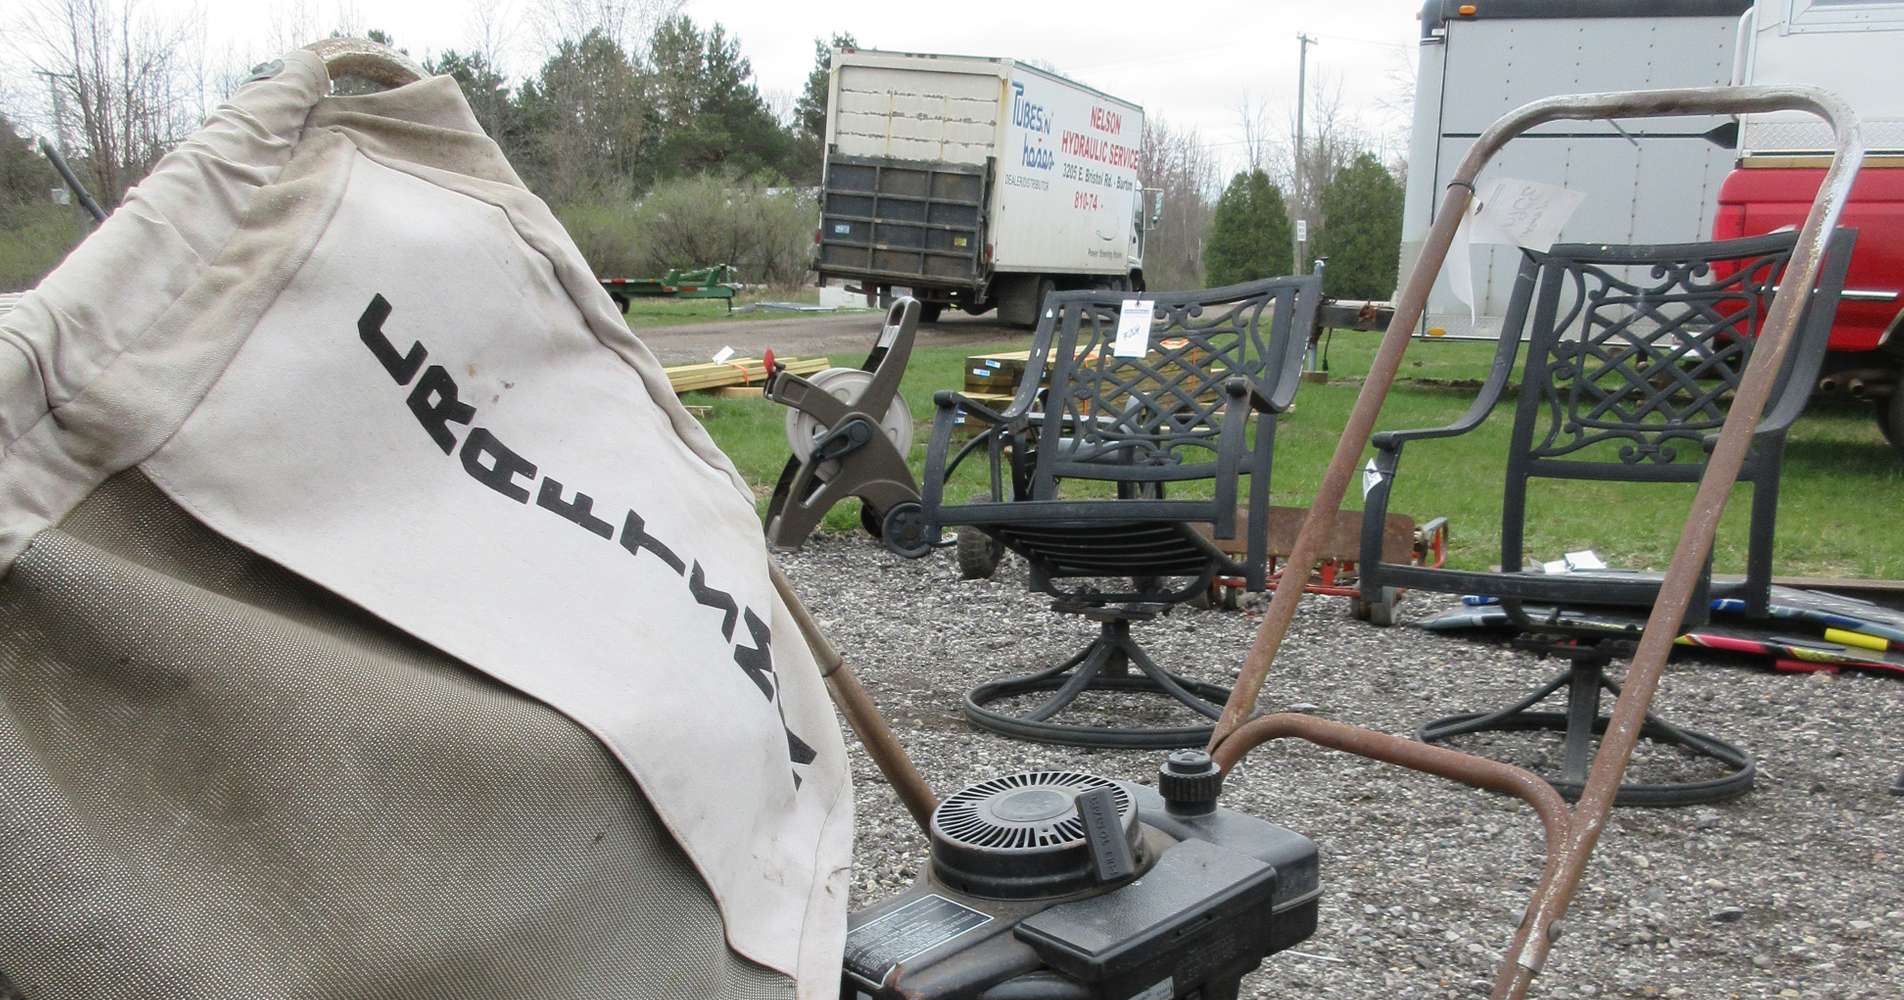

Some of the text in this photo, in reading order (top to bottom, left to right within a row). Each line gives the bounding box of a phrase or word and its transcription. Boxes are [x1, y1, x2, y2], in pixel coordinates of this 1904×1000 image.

[1012, 81, 1043, 132] TUBES
[1090, 105, 1121, 135] NELSON
[1062, 130, 1138, 170] HYDRAULIC SERVICE
[1063, 162, 1077, 180] 3205
[1085, 168, 1103, 185] Bristol
[357, 293, 818, 792] CRAFTSM
